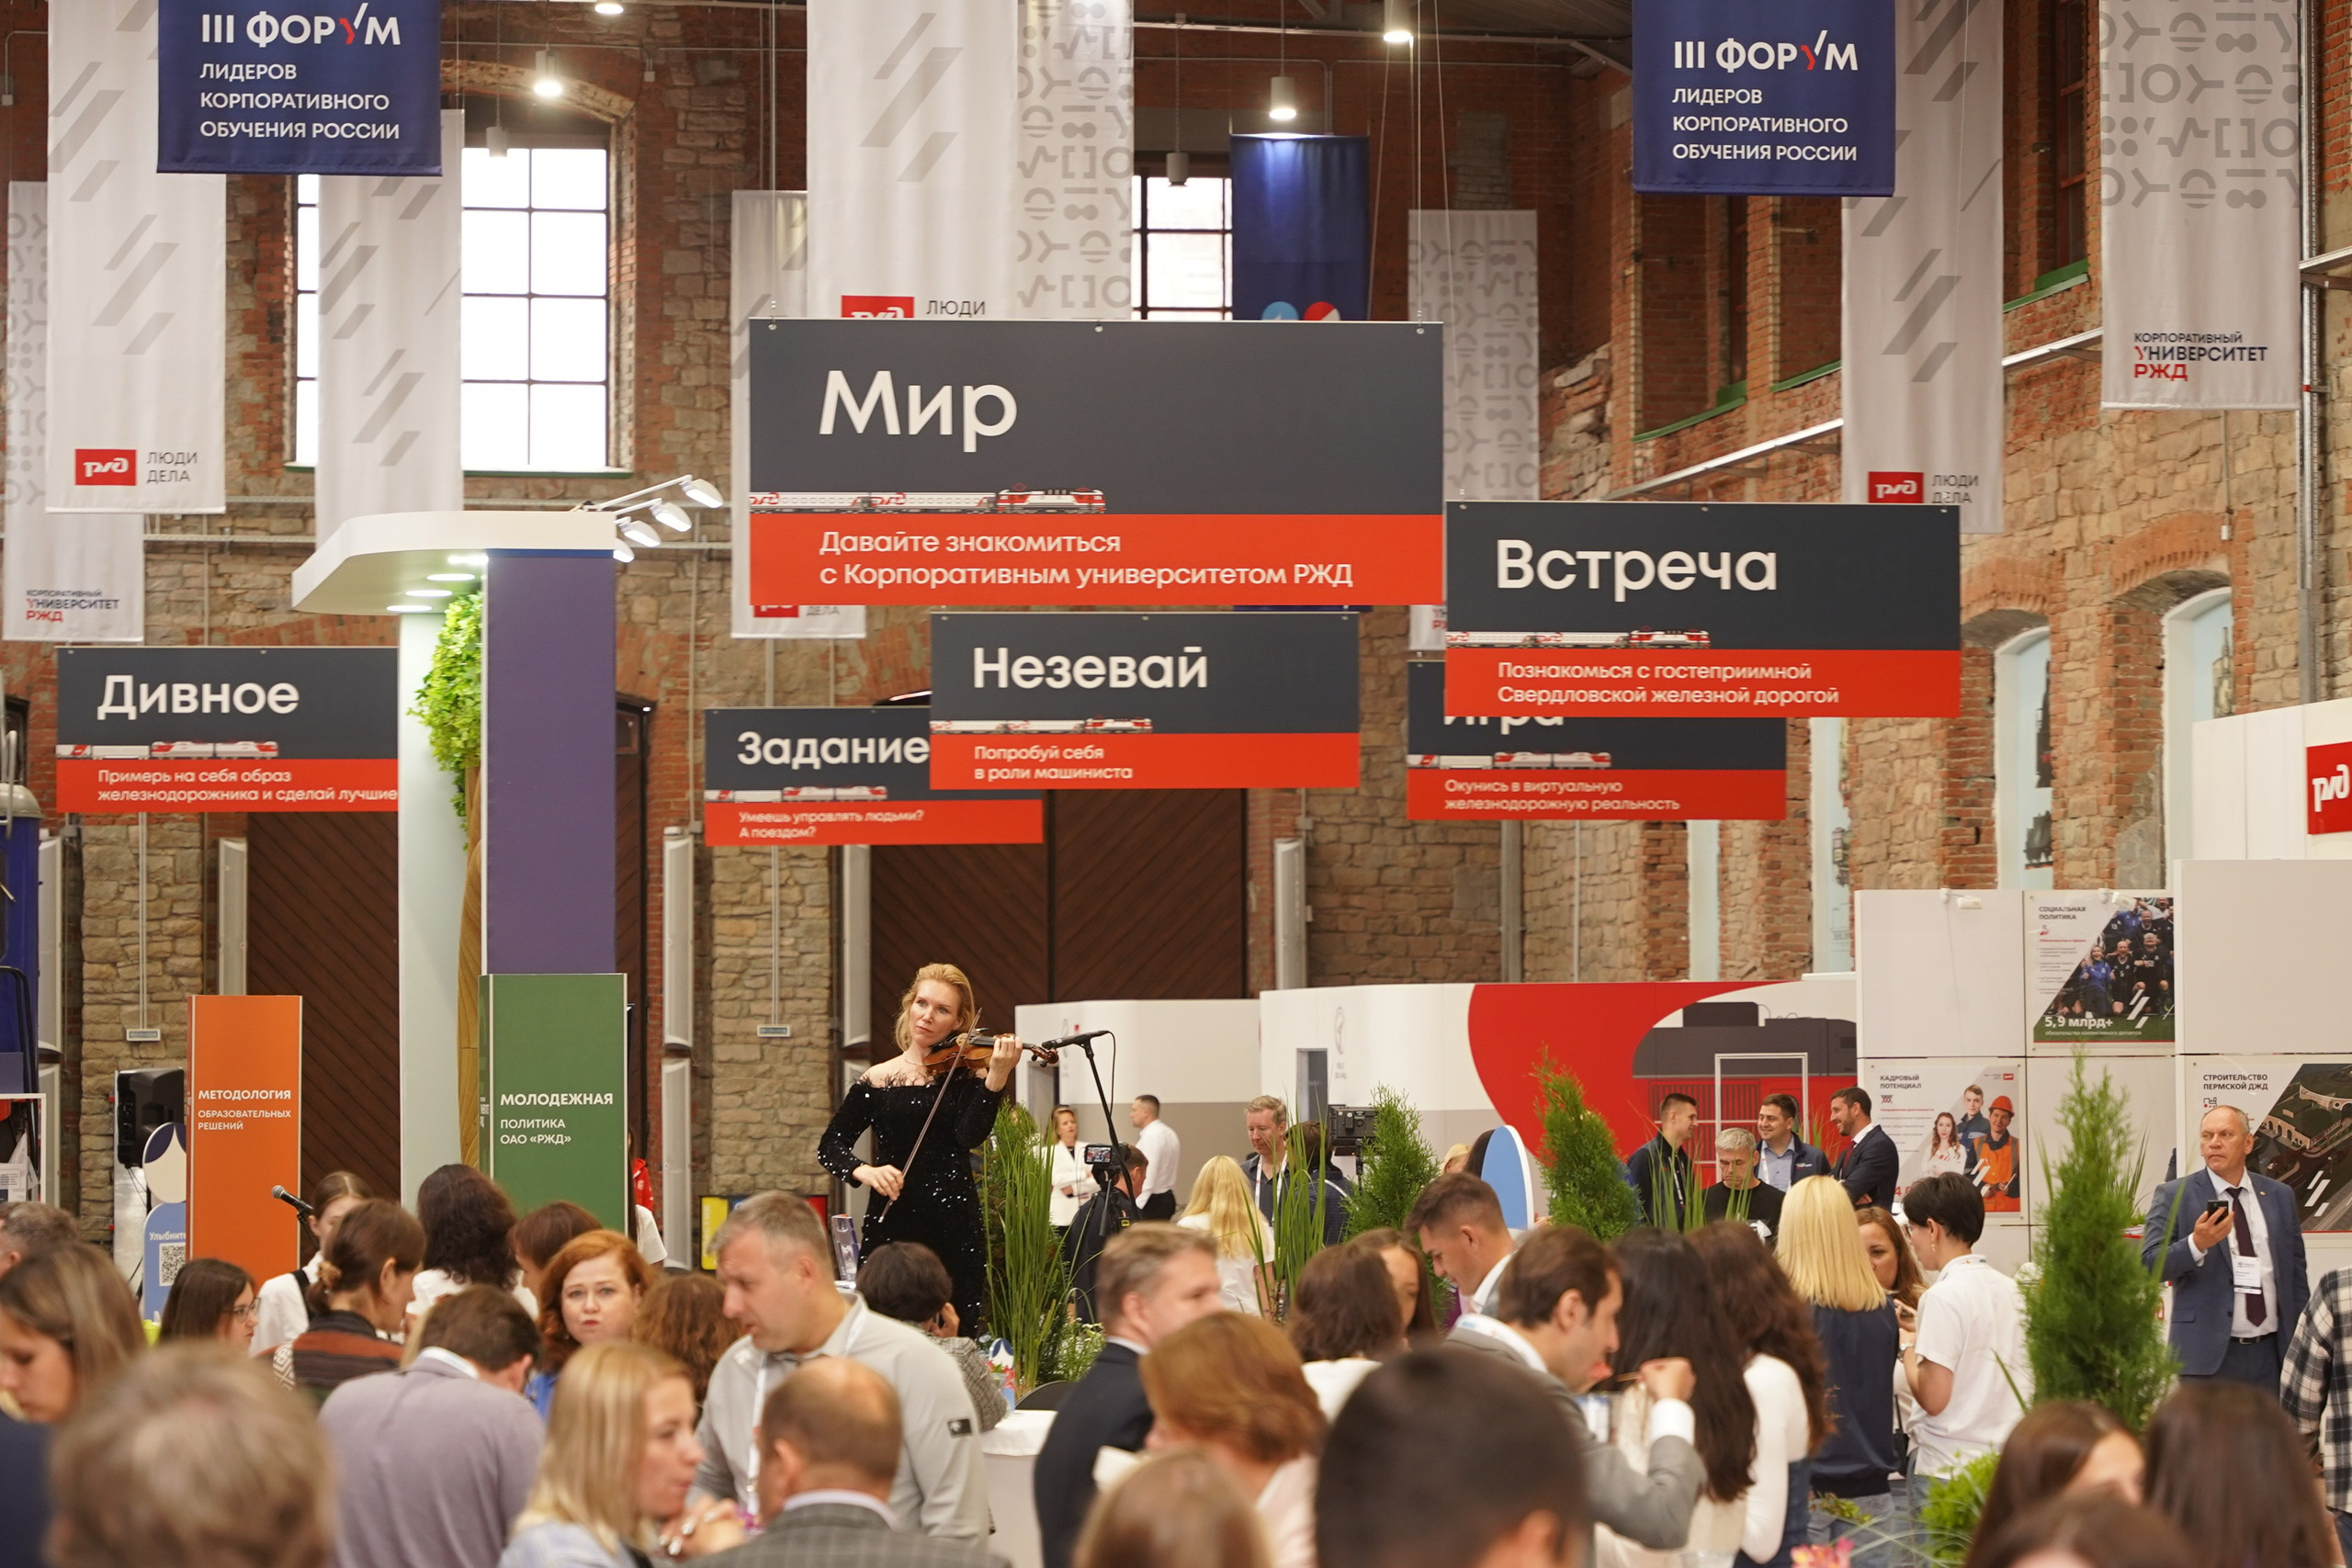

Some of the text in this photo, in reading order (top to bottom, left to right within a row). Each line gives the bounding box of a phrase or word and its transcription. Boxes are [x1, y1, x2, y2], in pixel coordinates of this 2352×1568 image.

[202, 2, 401, 48] III ФОРУМ
[1674, 29, 1859, 73] III ФОРУМ
[199, 62, 297, 83] ЛИДЕРОВ
[200, 92, 390, 110] КОРПОРАТИВНОГО
[1671, 88, 1763, 107] ЛИДЕРОВ
[199, 120, 400, 140] ОБУЧЕНИЯ РОССИИ
[1673, 116, 1849, 133] КОРПОРАТИВНОГО
[1672, 143, 1857, 162] ОБУЧЕНИЯ РОССИИ
[926, 299, 986, 318] ЛЮДИ
[2132, 330, 2245, 344] КОРПОРАТИВНЫЙ
[2133, 345, 2268, 362] УНИВЕРСИТЕТ
[2132, 363, 2189, 382] РЖД
[819, 369, 1017, 453] Мир
[147, 452, 198, 466] ЛЮДИ
[146, 470, 191, 484] ДЕЛА
[1932, 475, 1979, 488] ЛЮДИ
[1932, 492, 1973, 503] ДЕЛА
[819, 531, 1121, 556] Давайте знакомиться
[820, 563, 1353, 590] с Корпоративным университетом РЖД
[1497, 539, 1777, 603] Встреча
[26, 589, 102, 597] КОРПОРАТИВНЫЙ
[27, 599, 119, 609] УНИВЕРСИТЕТ
[26, 610, 63, 623] РЖД
[973, 646, 1207, 689] Незевай
[1498, 661, 1812, 682] Познакомься с гостеприимной
[96, 674, 300, 721] Дивное
[1498, 685, 1839, 707] Свердловской железной дорогой
[737, 730, 930, 771] Задание
[974, 744, 1104, 762] Попробуй себя
[98, 768, 292, 785] Примерь на себя образ
[974, 767, 1133, 783] в роли машиниста
[97, 786, 398, 804] железнодорожника и сделай лучшие
[1444, 779, 1623, 795] Окунись в виртуальную
[1444, 799, 1680, 813] железнодорожную реальность
[738, 808, 924, 825] Умеешь управлять людьми?
[739, 825, 817, 839] А поездом?
[2044, 1017, 2065, 1028] 5,9
[1880, 1074, 1919, 1082] КАДРОВЫЙ
[2203, 1082, 2246, 1090] ПЕРМСКОЙ
[198, 1090, 291, 1100] МЕТОДОЛОГИЯ
[500, 1093, 614, 1107] МОЛОДЕЖНАЯ
[198, 1110, 291, 1118] ОБРАЗОВАТЕЛЬНЫХ
[198, 1121, 243, 1130] РЕШЕНИЙ
[500, 1119, 566, 1129] ПОЛИТИКА
[500, 1134, 571, 1145] ОАО «РЖД»
